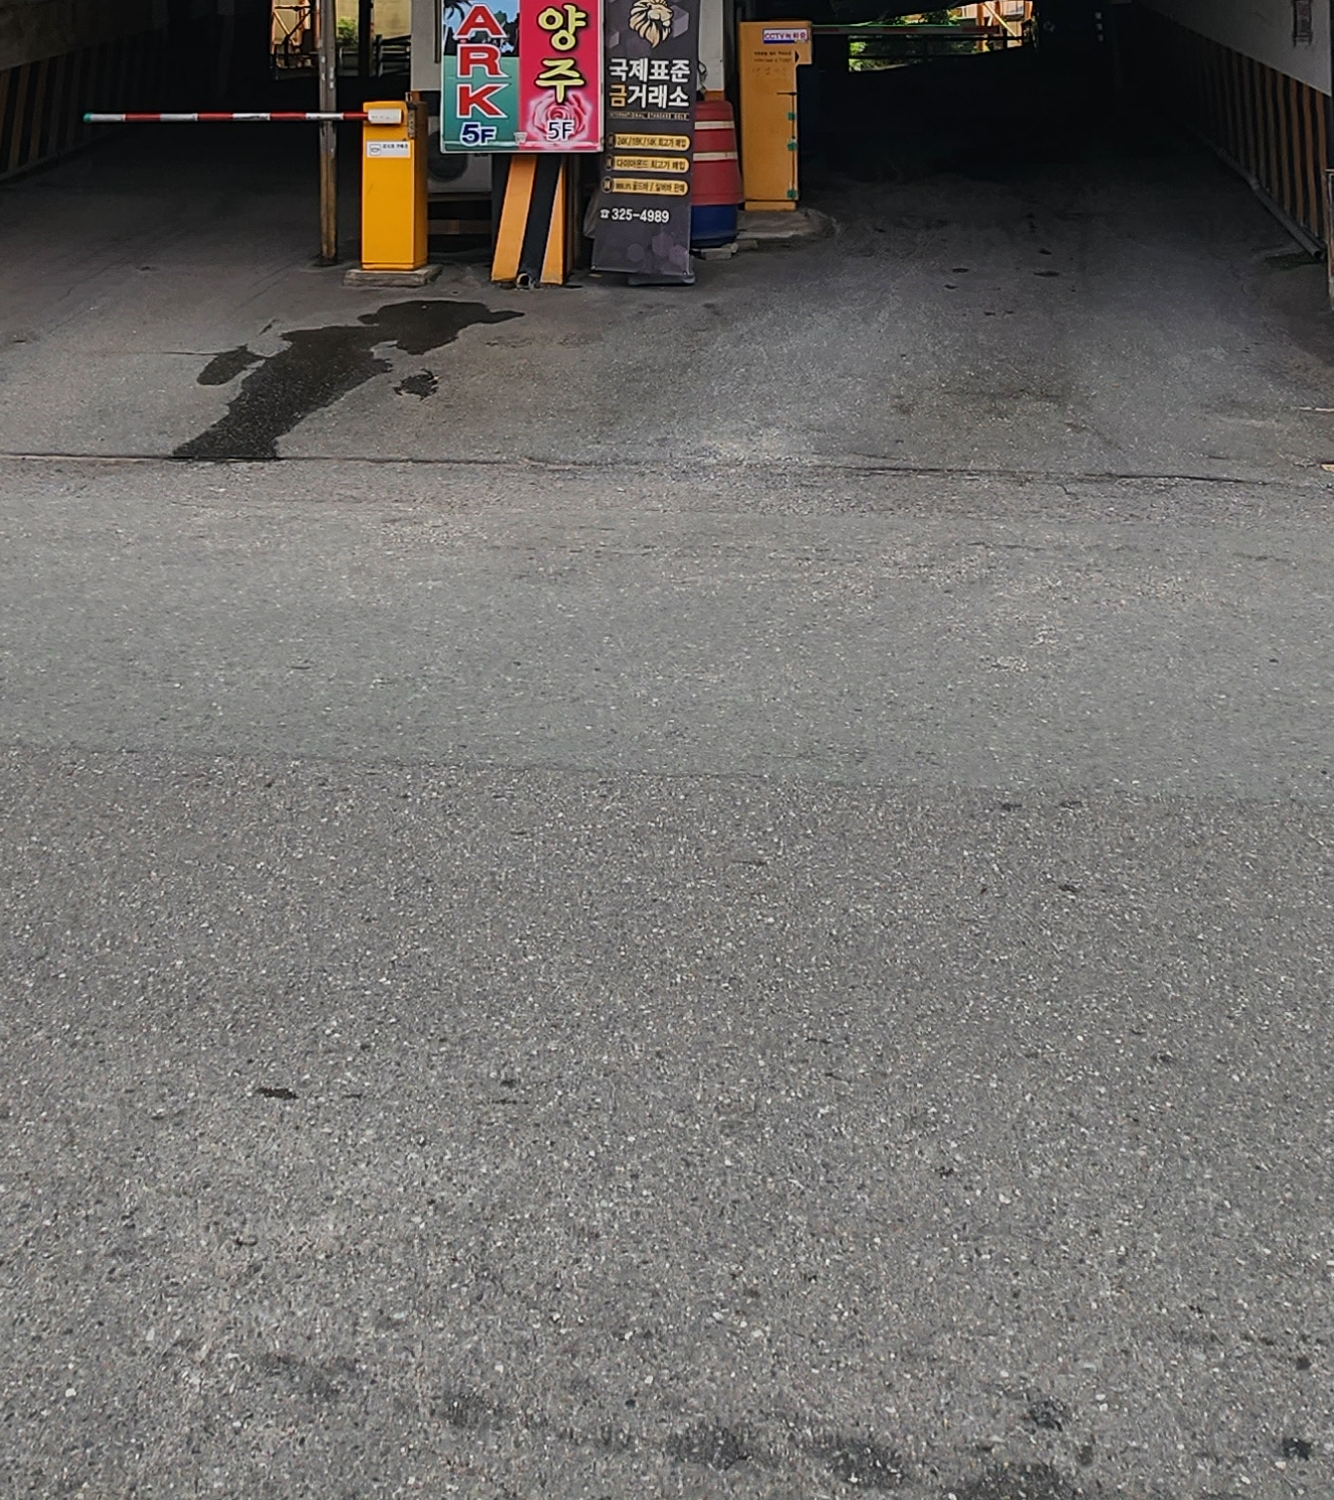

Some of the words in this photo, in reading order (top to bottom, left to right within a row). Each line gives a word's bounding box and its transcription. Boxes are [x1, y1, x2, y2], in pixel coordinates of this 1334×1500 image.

[609, 58, 691, 83] 국제표준
[609, 84, 690, 109] 금거래소
[460, 121, 497, 146] 5F
[546, 119, 575, 141] 5F
[611, 208, 670, 223] 325-4989
